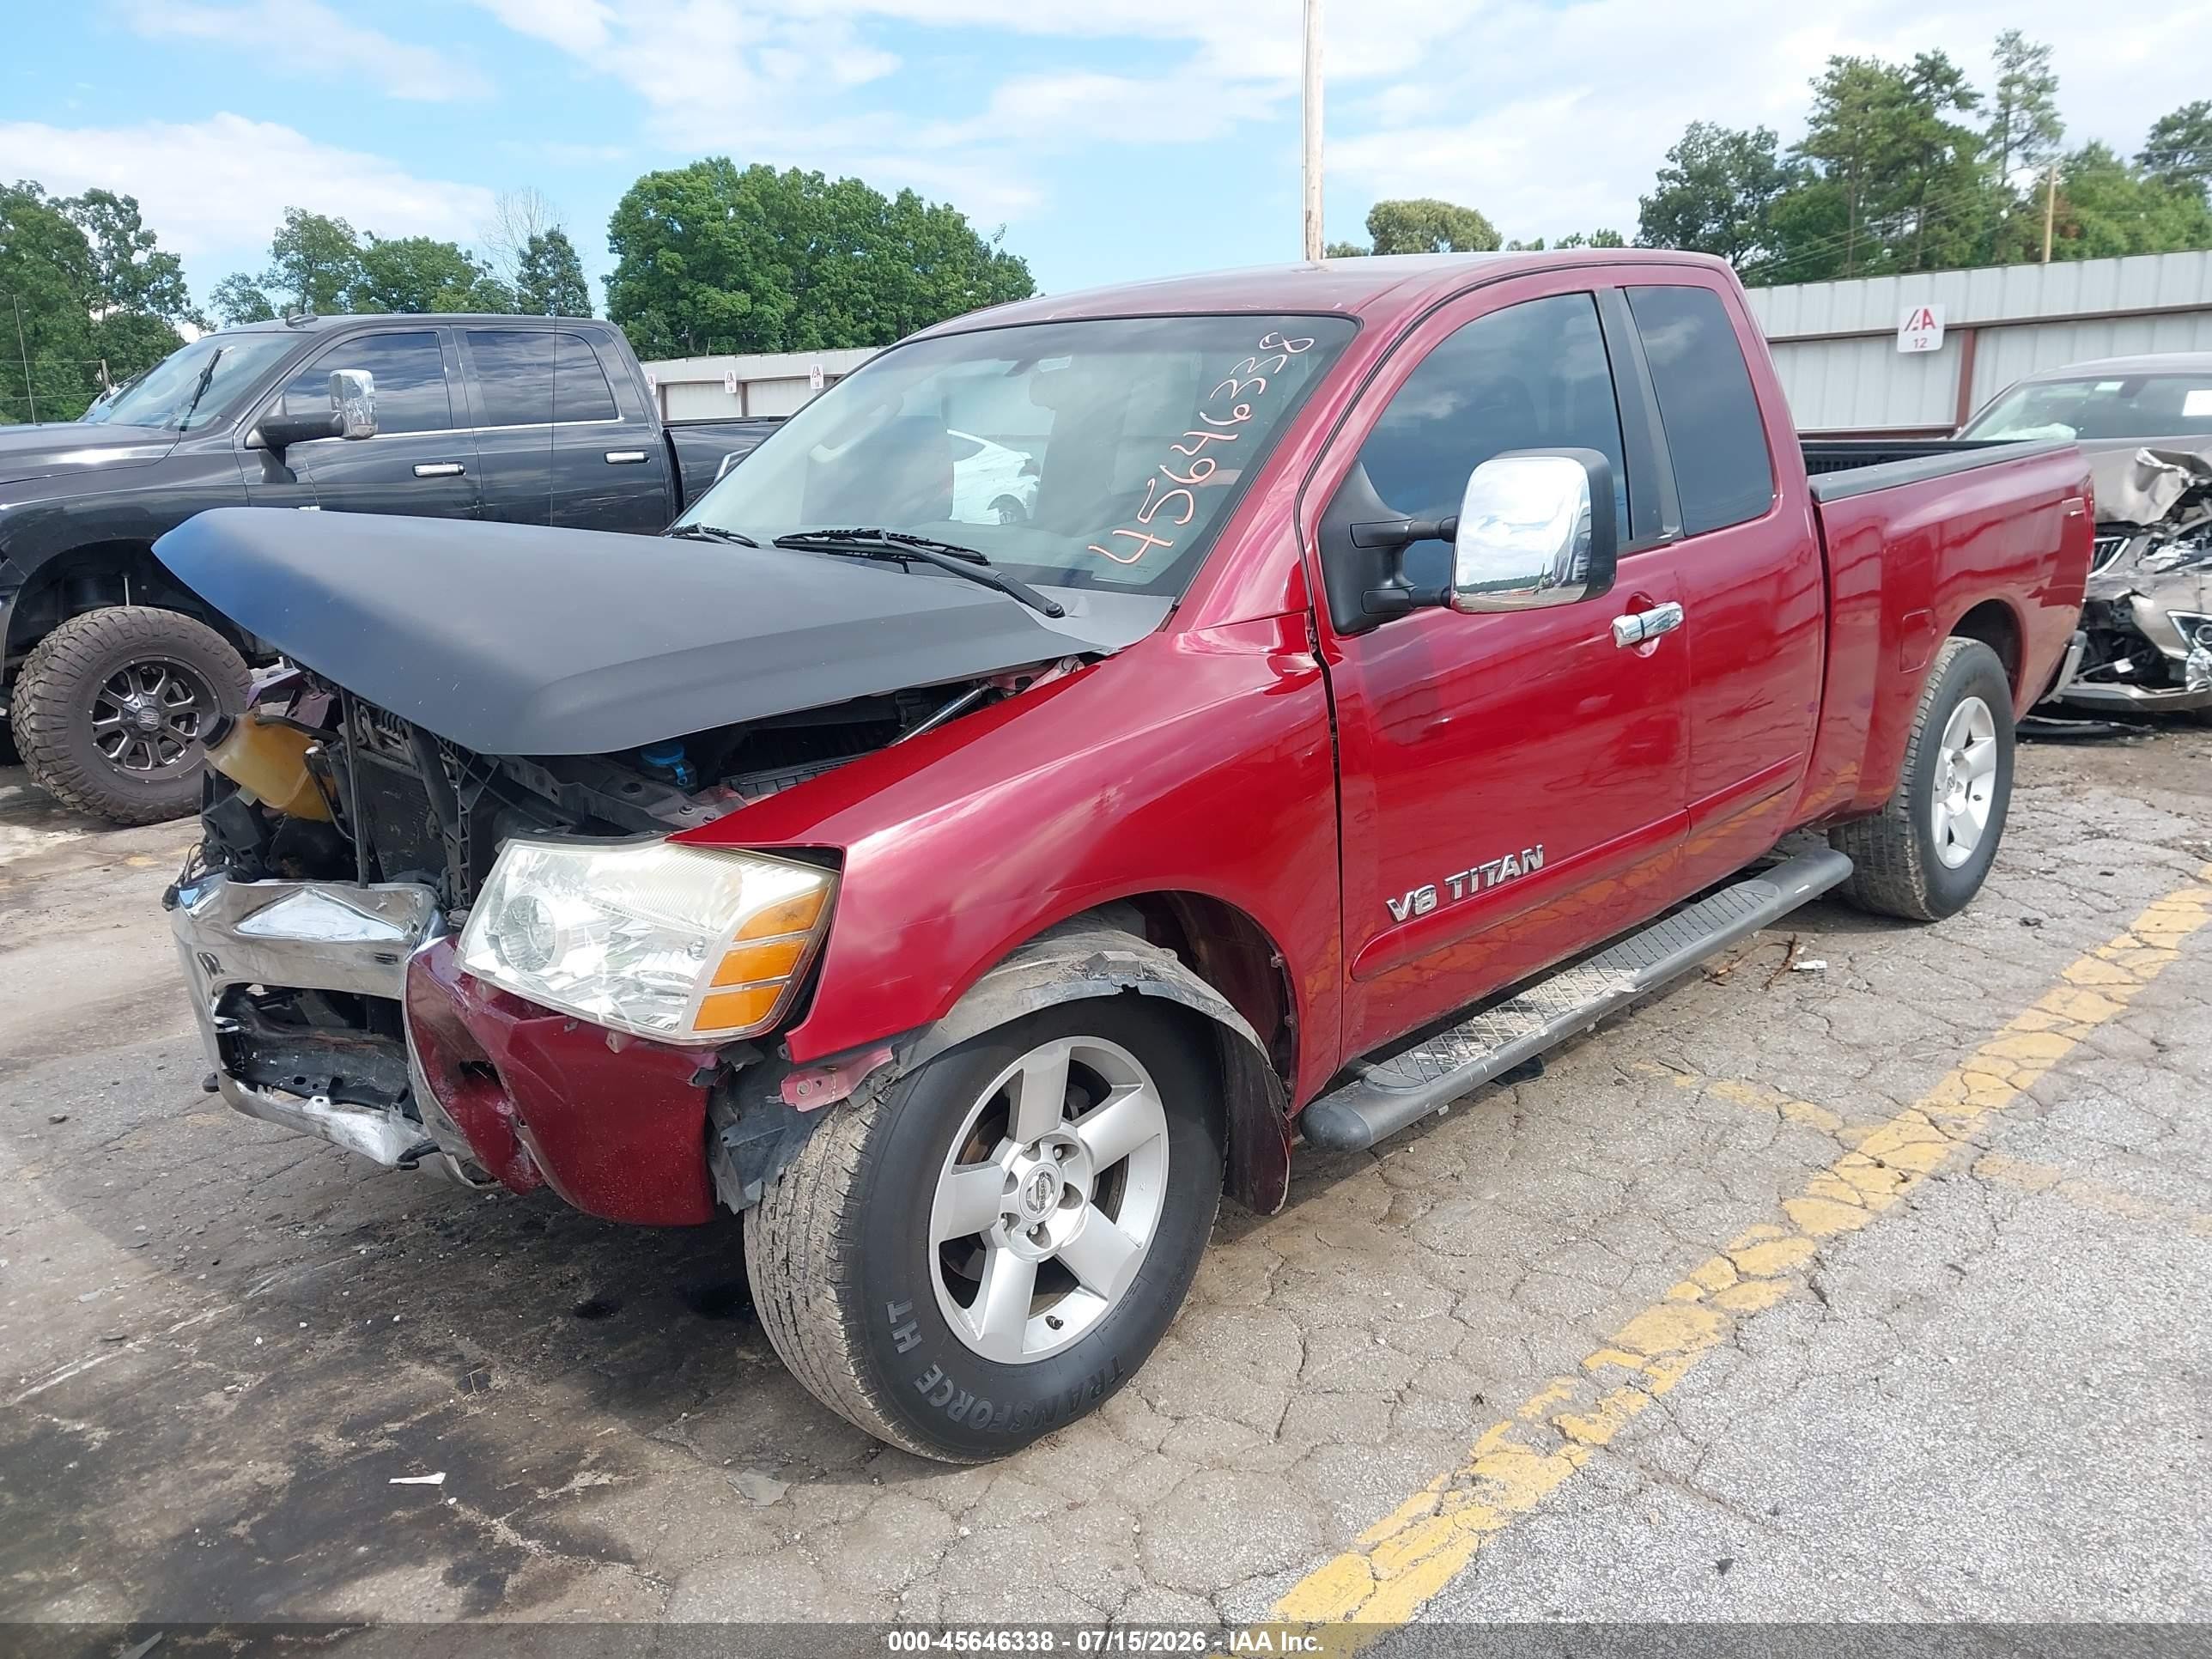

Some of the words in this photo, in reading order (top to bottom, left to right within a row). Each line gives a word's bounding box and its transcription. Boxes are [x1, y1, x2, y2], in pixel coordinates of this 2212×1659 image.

[1913, 337, 1928, 349] 12
[1087, 331, 1315, 564] 45646338
[1385, 884, 1438, 922] V8
[1444, 844, 1544, 900] TITAN
[885, 1297, 923, 1354] HT
[913, 1356, 1125, 1433] TRANSFORCE
